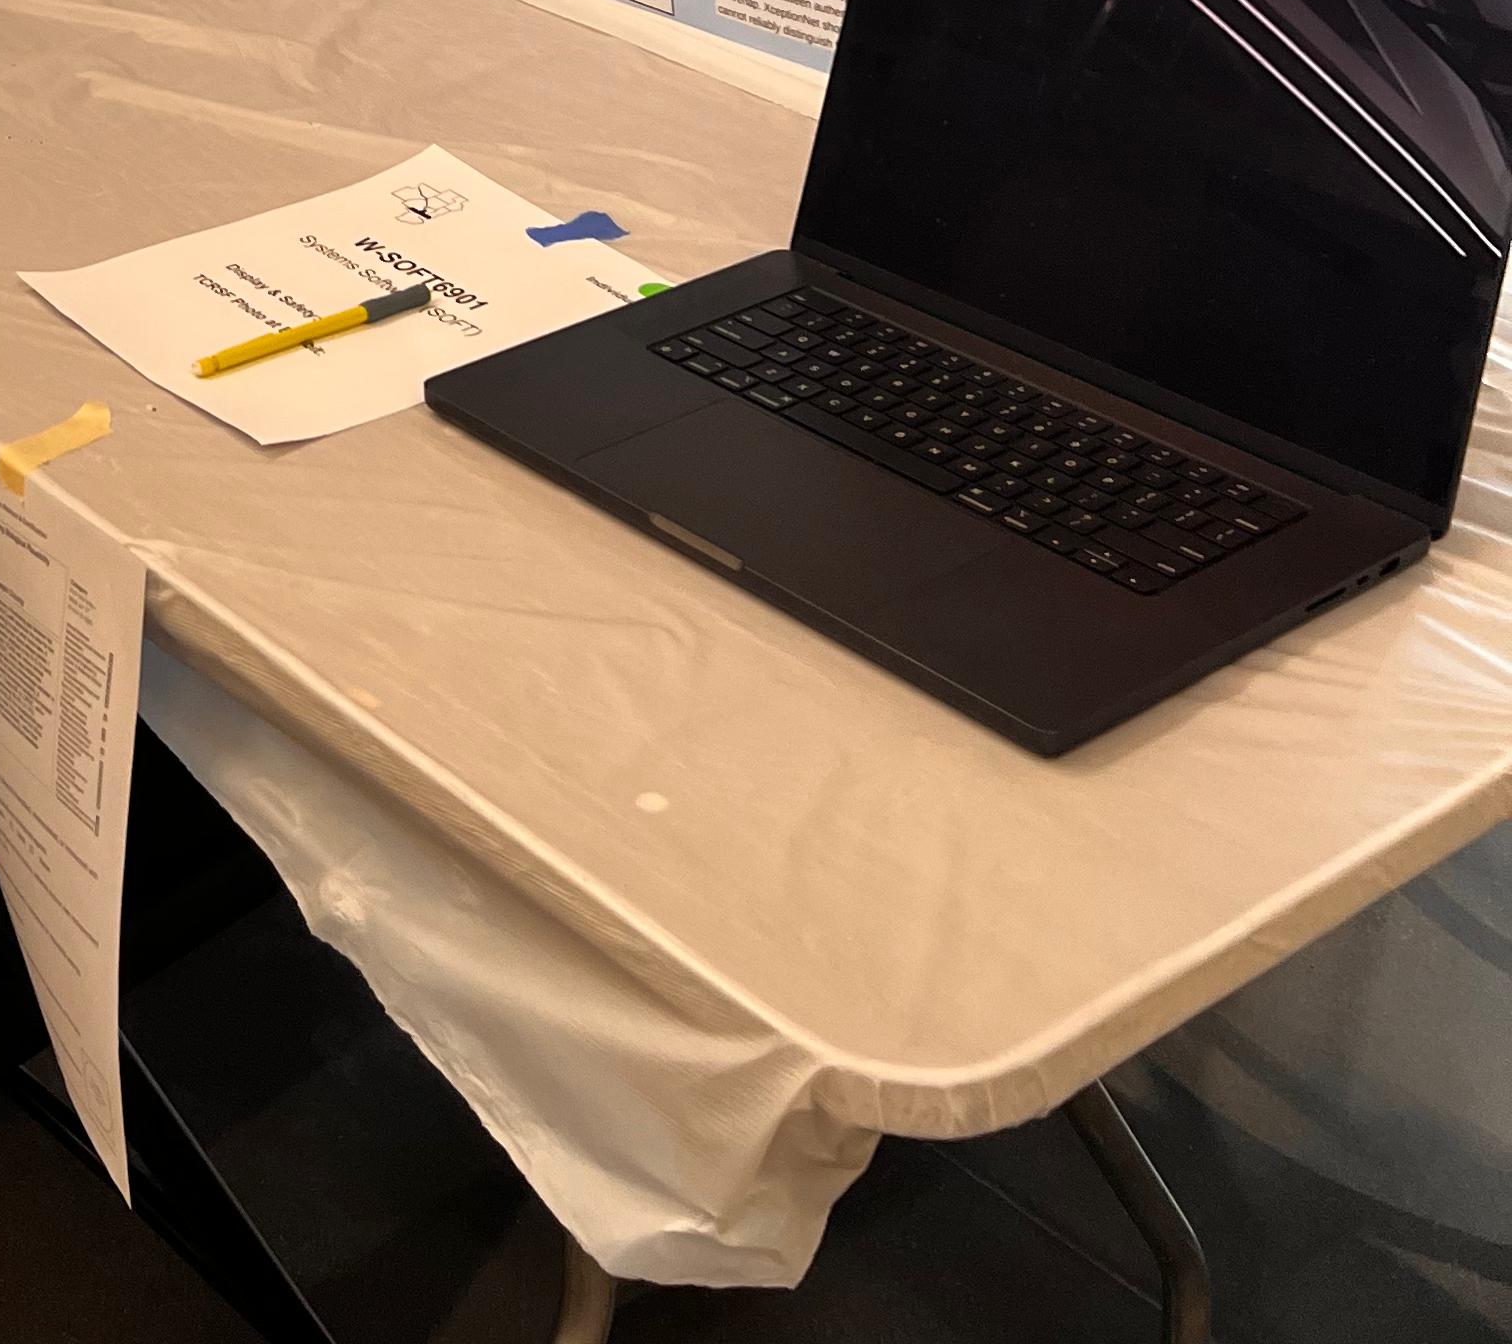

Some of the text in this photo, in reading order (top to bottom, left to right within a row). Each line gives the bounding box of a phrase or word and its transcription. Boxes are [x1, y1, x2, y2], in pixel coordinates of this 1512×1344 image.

[300, 234, 358, 271] Systems
[355, 236, 488, 310] W-SOFT6901
[226, 263, 268, 290] Display
[193, 274, 282, 328] TCRSF Photo at
